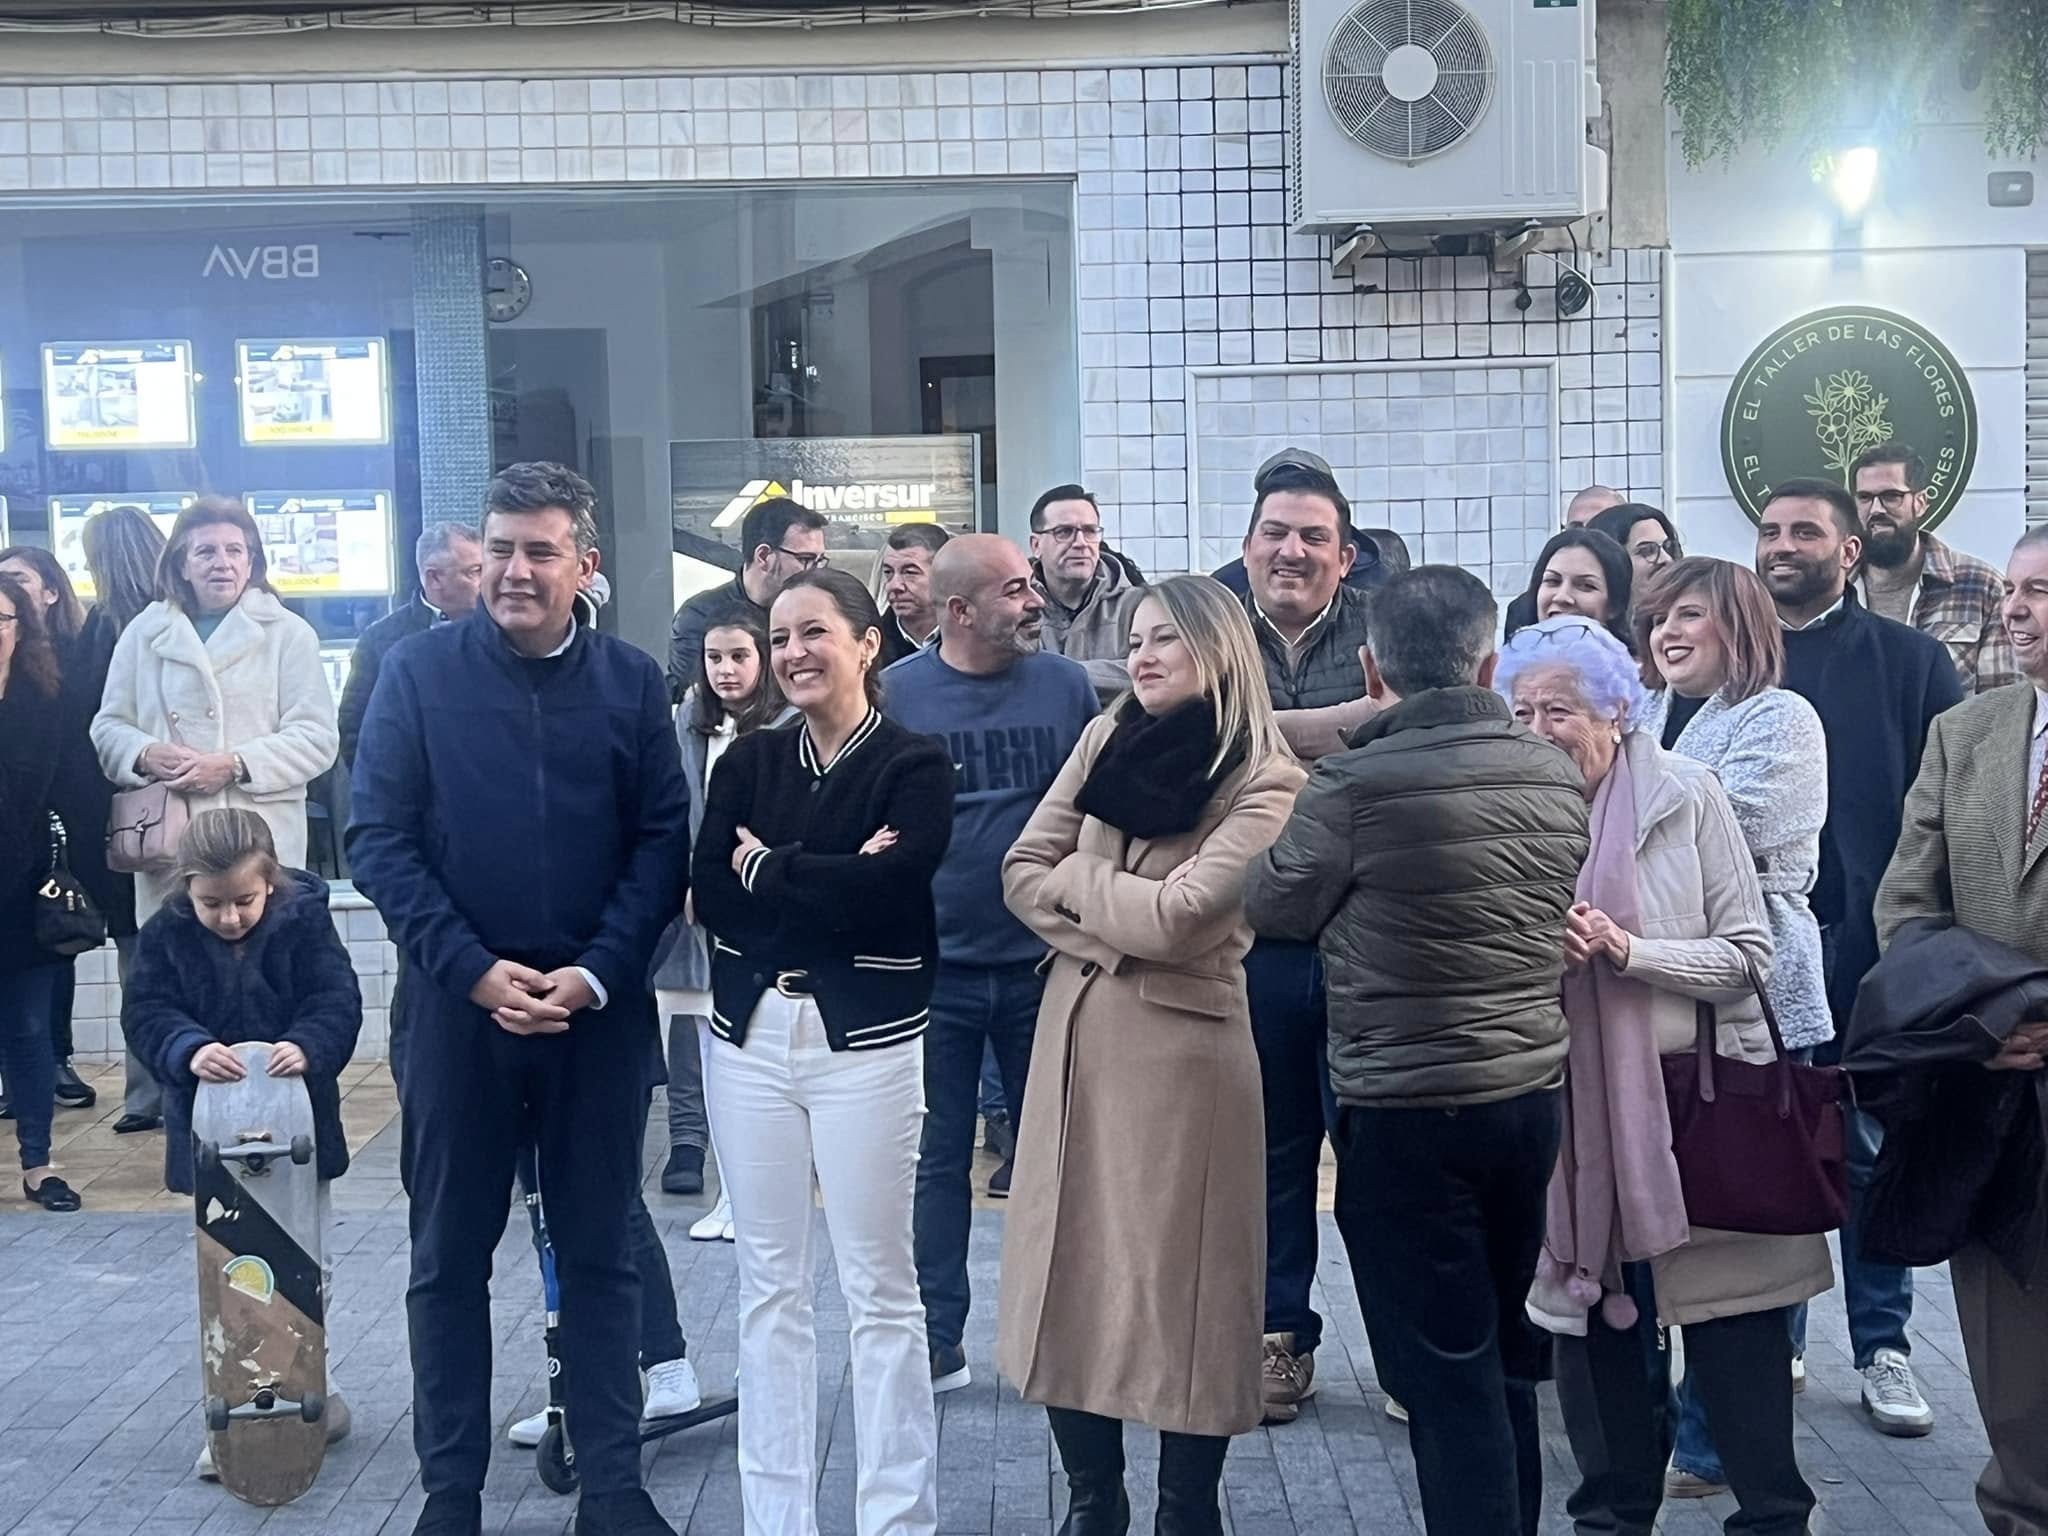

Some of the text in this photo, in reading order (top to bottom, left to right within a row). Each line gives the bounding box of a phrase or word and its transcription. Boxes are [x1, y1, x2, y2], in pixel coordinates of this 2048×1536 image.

[1743, 324, 1954, 420] EL TALLER DE LAS FLORES
[792, 479, 935, 510] Inversur
[1744, 447, 1955, 499] EL ORES
